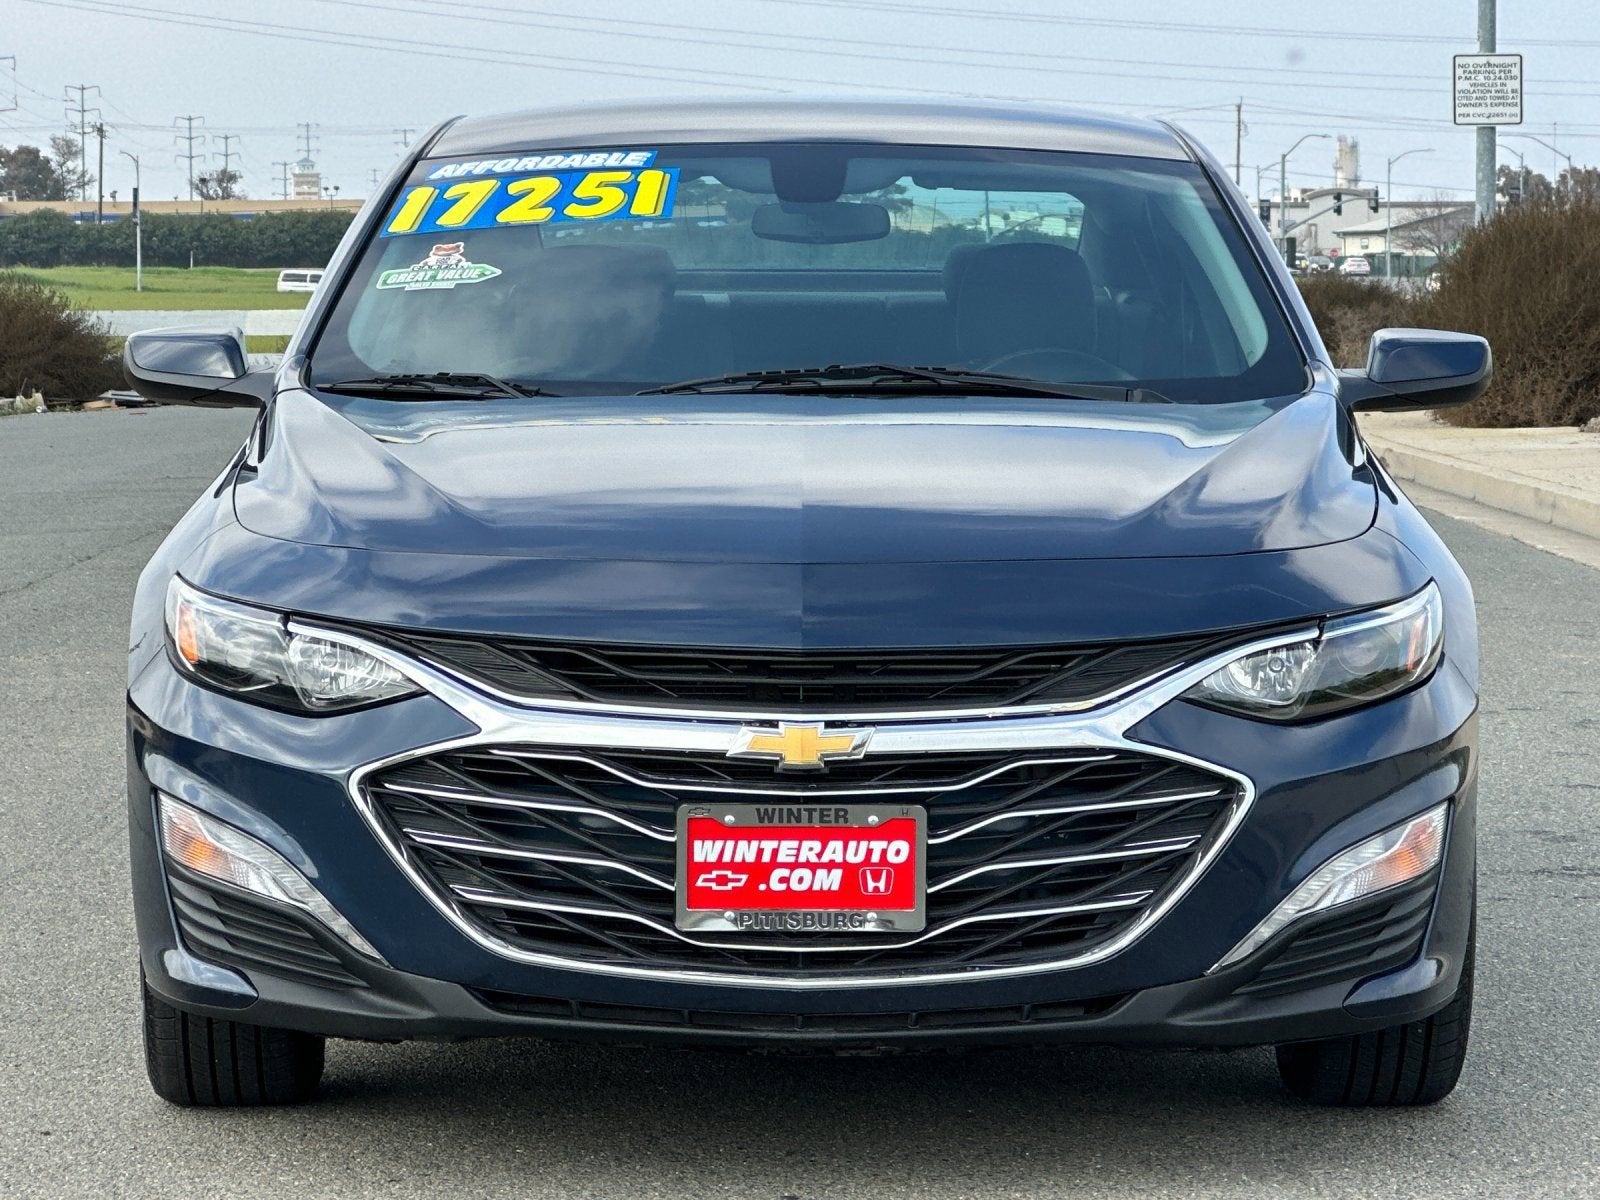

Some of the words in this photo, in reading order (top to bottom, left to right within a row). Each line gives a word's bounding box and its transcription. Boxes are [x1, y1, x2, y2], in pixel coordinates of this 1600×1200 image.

[430, 152, 652, 179] AFFORDABLE
[387, 170, 671, 234] 17251
[386, 271, 433, 284] GREAT
[436, 268, 480, 280] VALUE
[756, 808, 849, 824] WINTER
[693, 840, 910, 863] WINTERAUTO
[758, 868, 842, 891] .COM
[738, 912, 864, 929] PITTSBURG
